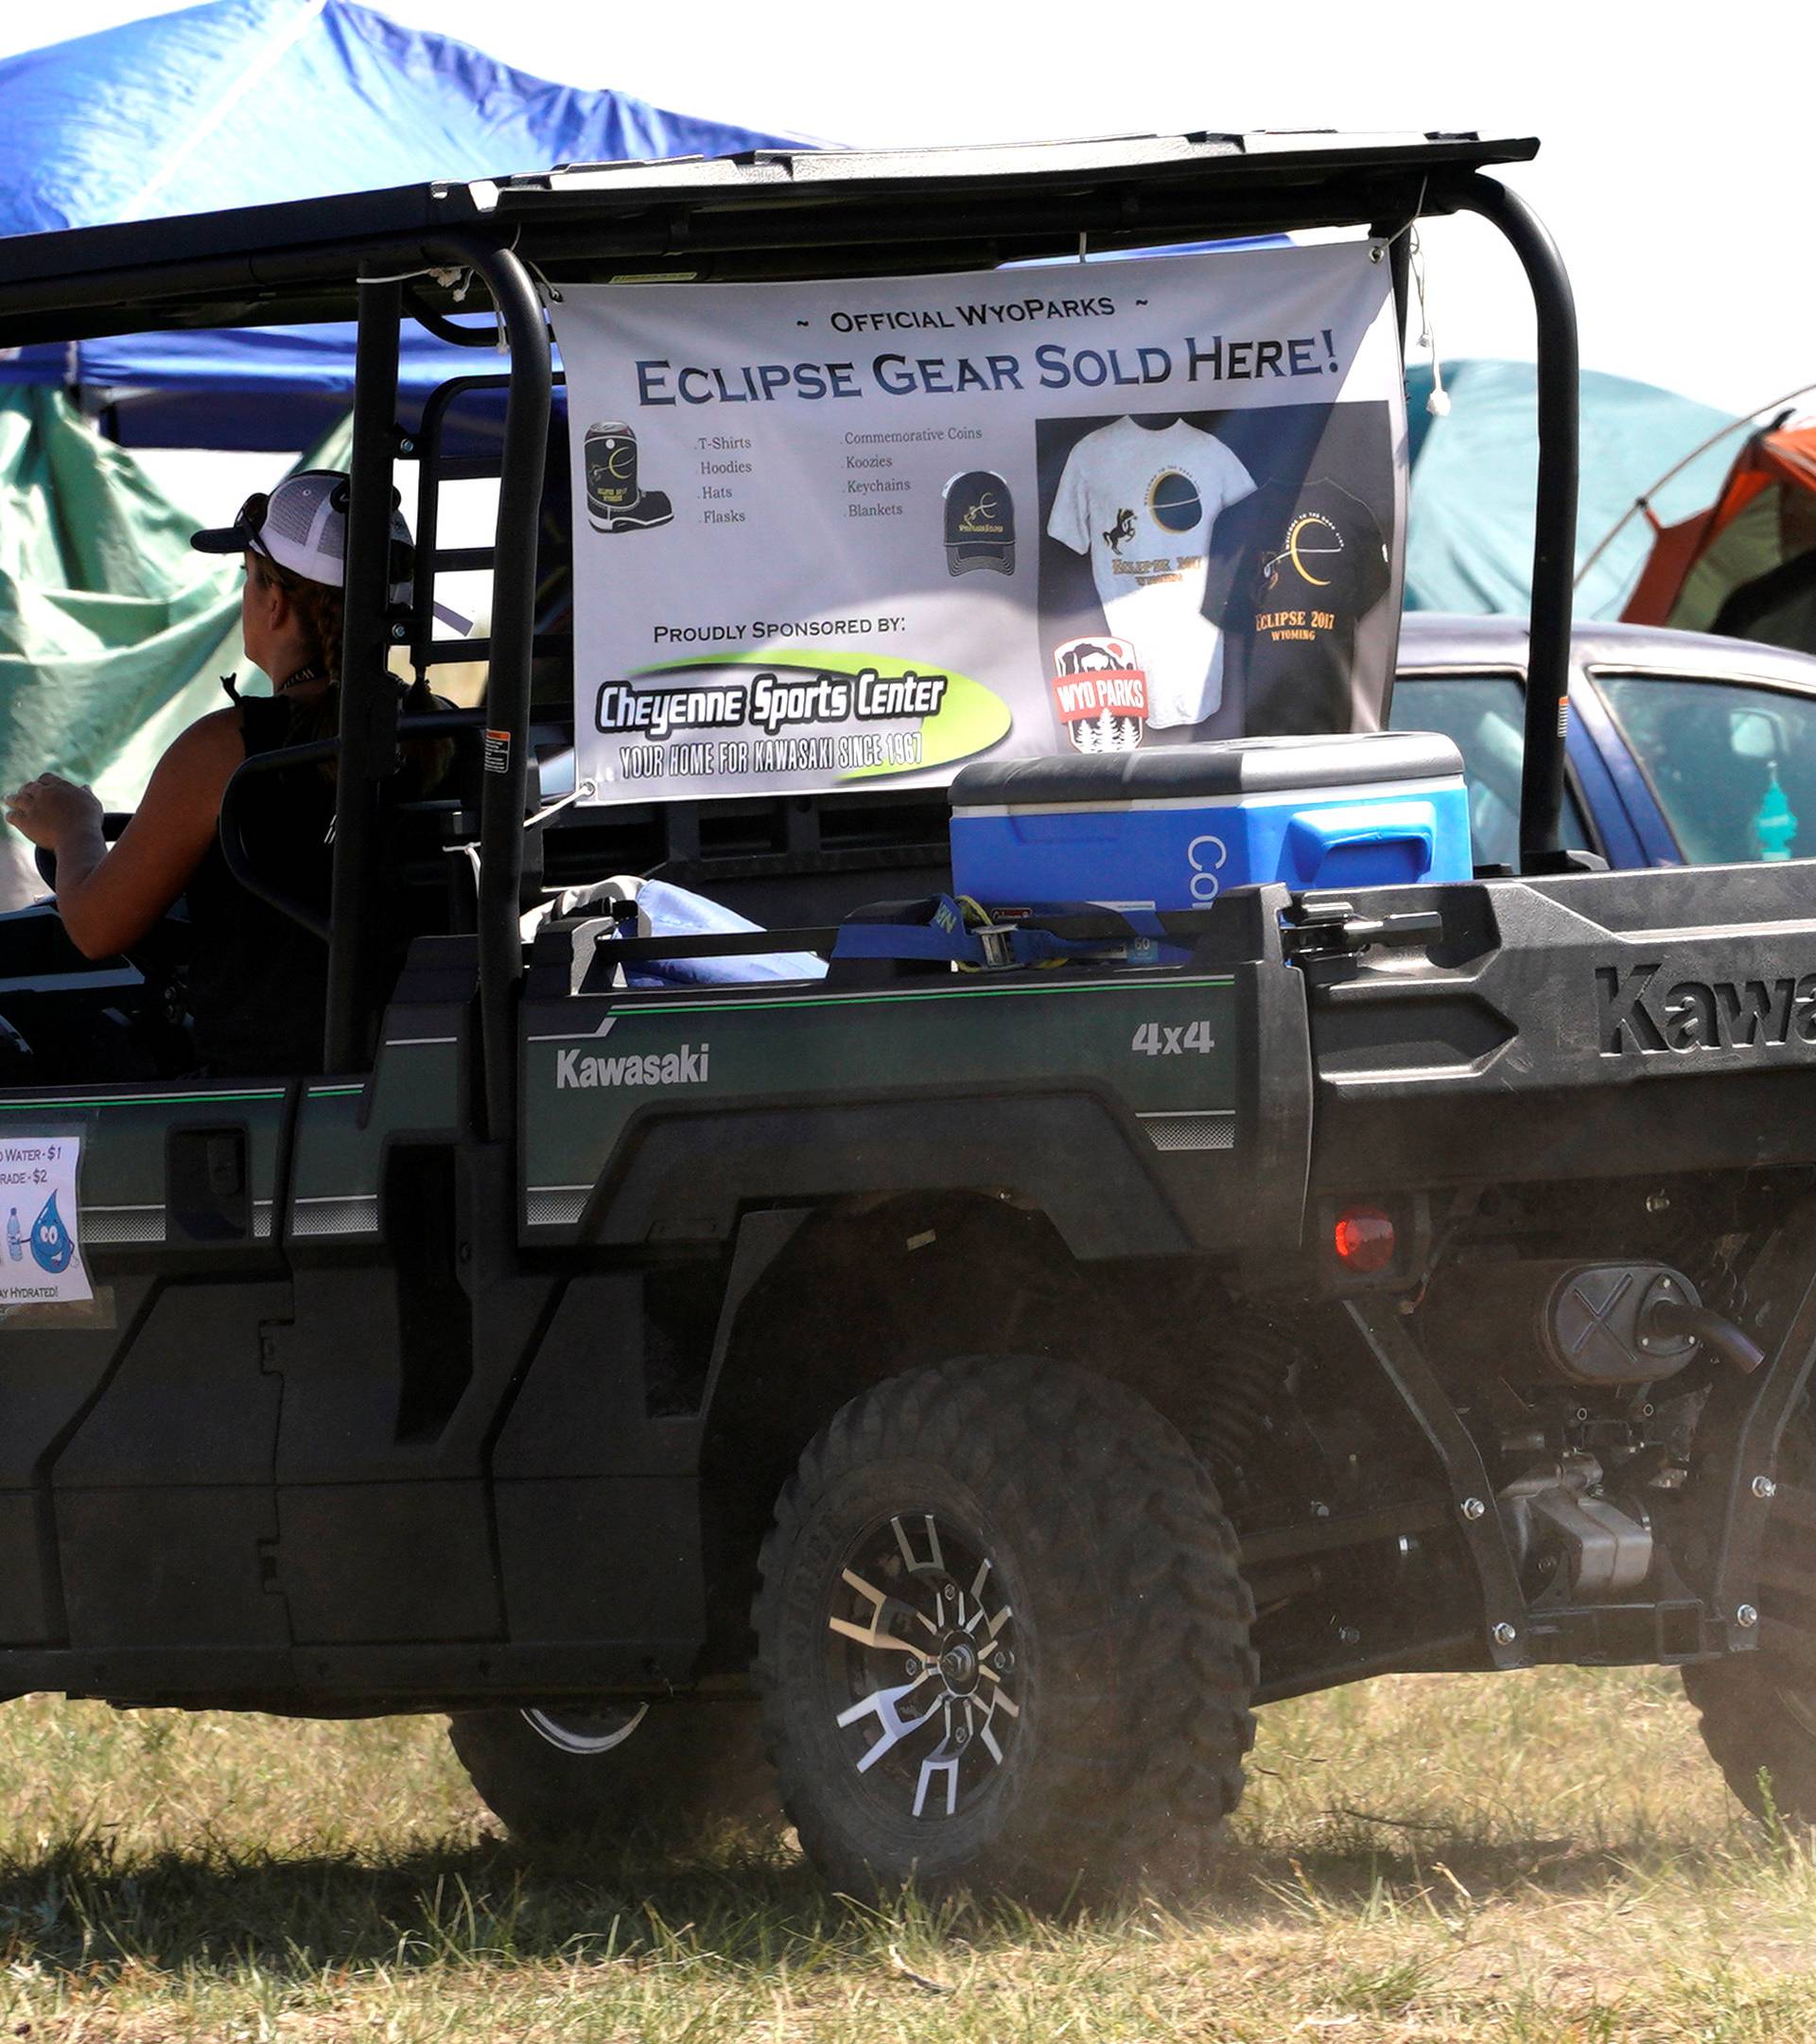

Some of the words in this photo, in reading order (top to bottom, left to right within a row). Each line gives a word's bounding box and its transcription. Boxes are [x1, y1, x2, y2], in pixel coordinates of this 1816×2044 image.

[830, 310, 953, 333] OFFICIAL
[636, 358, 863, 407] ECLIPSE
[872, 353, 1024, 395] GEAR
[1035, 343, 1173, 389] SOLD
[1185, 328, 1339, 383] HERE!
[845, 428, 944, 445] Commemorative
[948, 427, 983, 440] Coins
[701, 461, 752, 475] Hoodies
[846, 454, 893, 469] Koozies
[703, 486, 732, 499] Hats
[847, 478, 911, 496] Keychains
[704, 509, 745, 524] Flasks
[848, 503, 903, 518] Blankets
[654, 623, 746, 643] PROUDLY
[752, 619, 872, 639] SPONSORED
[878, 616, 906, 633] BY:
[1311, 610, 1335, 630] 2017
[1270, 629, 1316, 641] WYOMING
[751, 676, 849, 733] Sports
[856, 671, 946, 718] Center
[1096, 678, 1144, 709] PARKS
[620, 745, 664, 778] YOUR
[670, 742, 714, 777] HOME
[719, 741, 748, 775] FOR
[754, 737, 834, 774] KAWASAKI
[839, 733, 882, 770] SINCE
[886, 731, 923, 766] 1967
[1131, 1021, 1214, 1056] 4x4
[556, 1043, 709, 1089] Kawasaki
